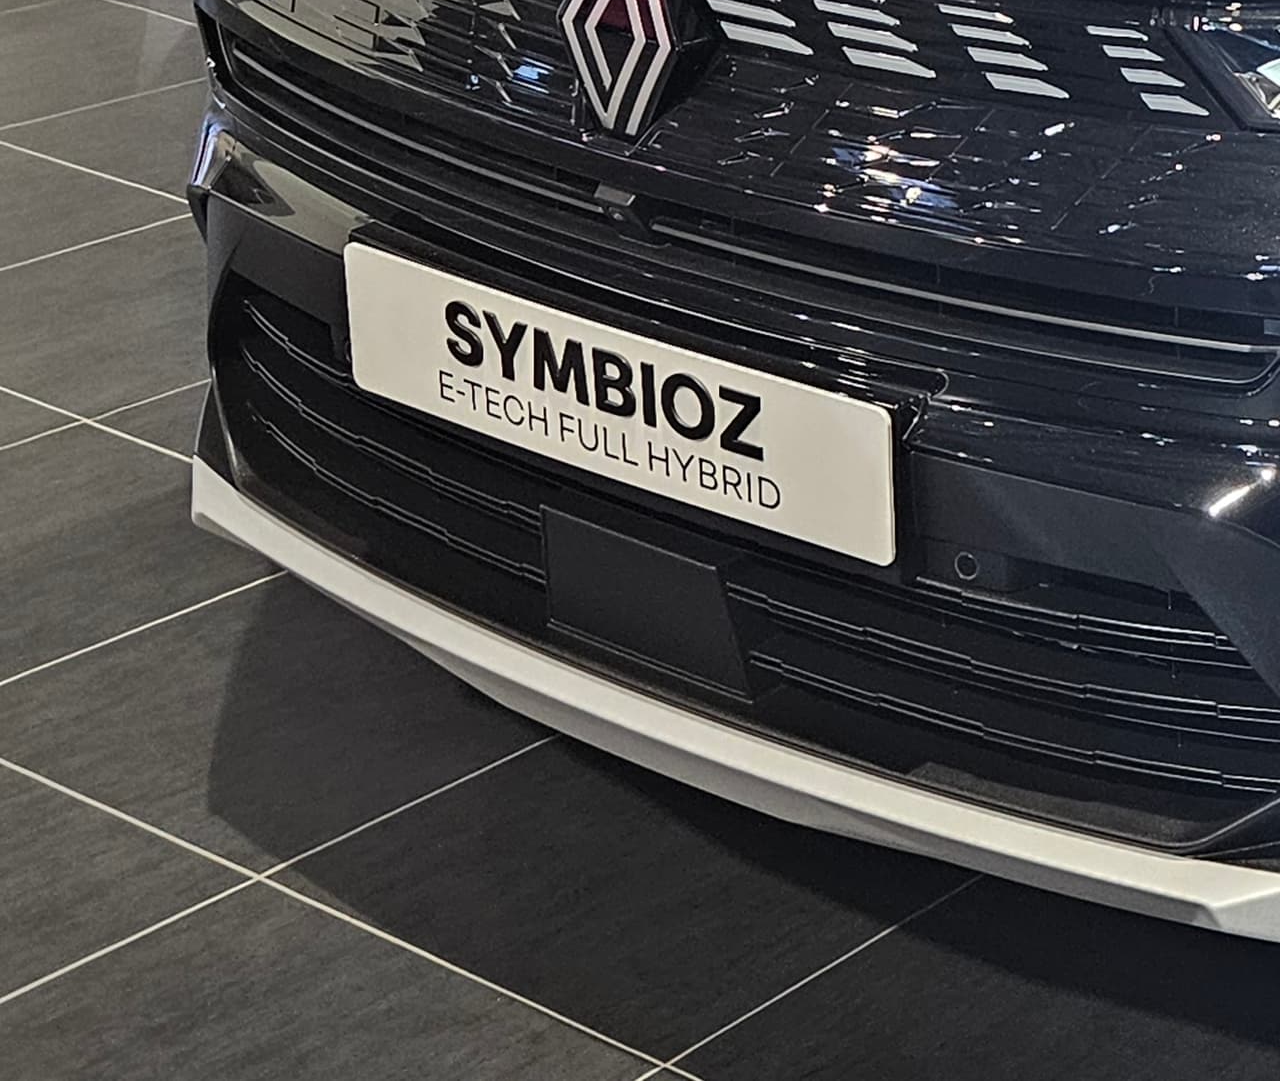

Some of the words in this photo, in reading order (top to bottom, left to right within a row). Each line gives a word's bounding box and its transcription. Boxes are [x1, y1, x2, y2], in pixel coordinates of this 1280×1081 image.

[438, 370, 551, 438] E-TECH
[560, 416, 639, 468] FULL
[648, 440, 782, 511] HYBRID
[443, 299, 764, 462] SYMBIOZ
